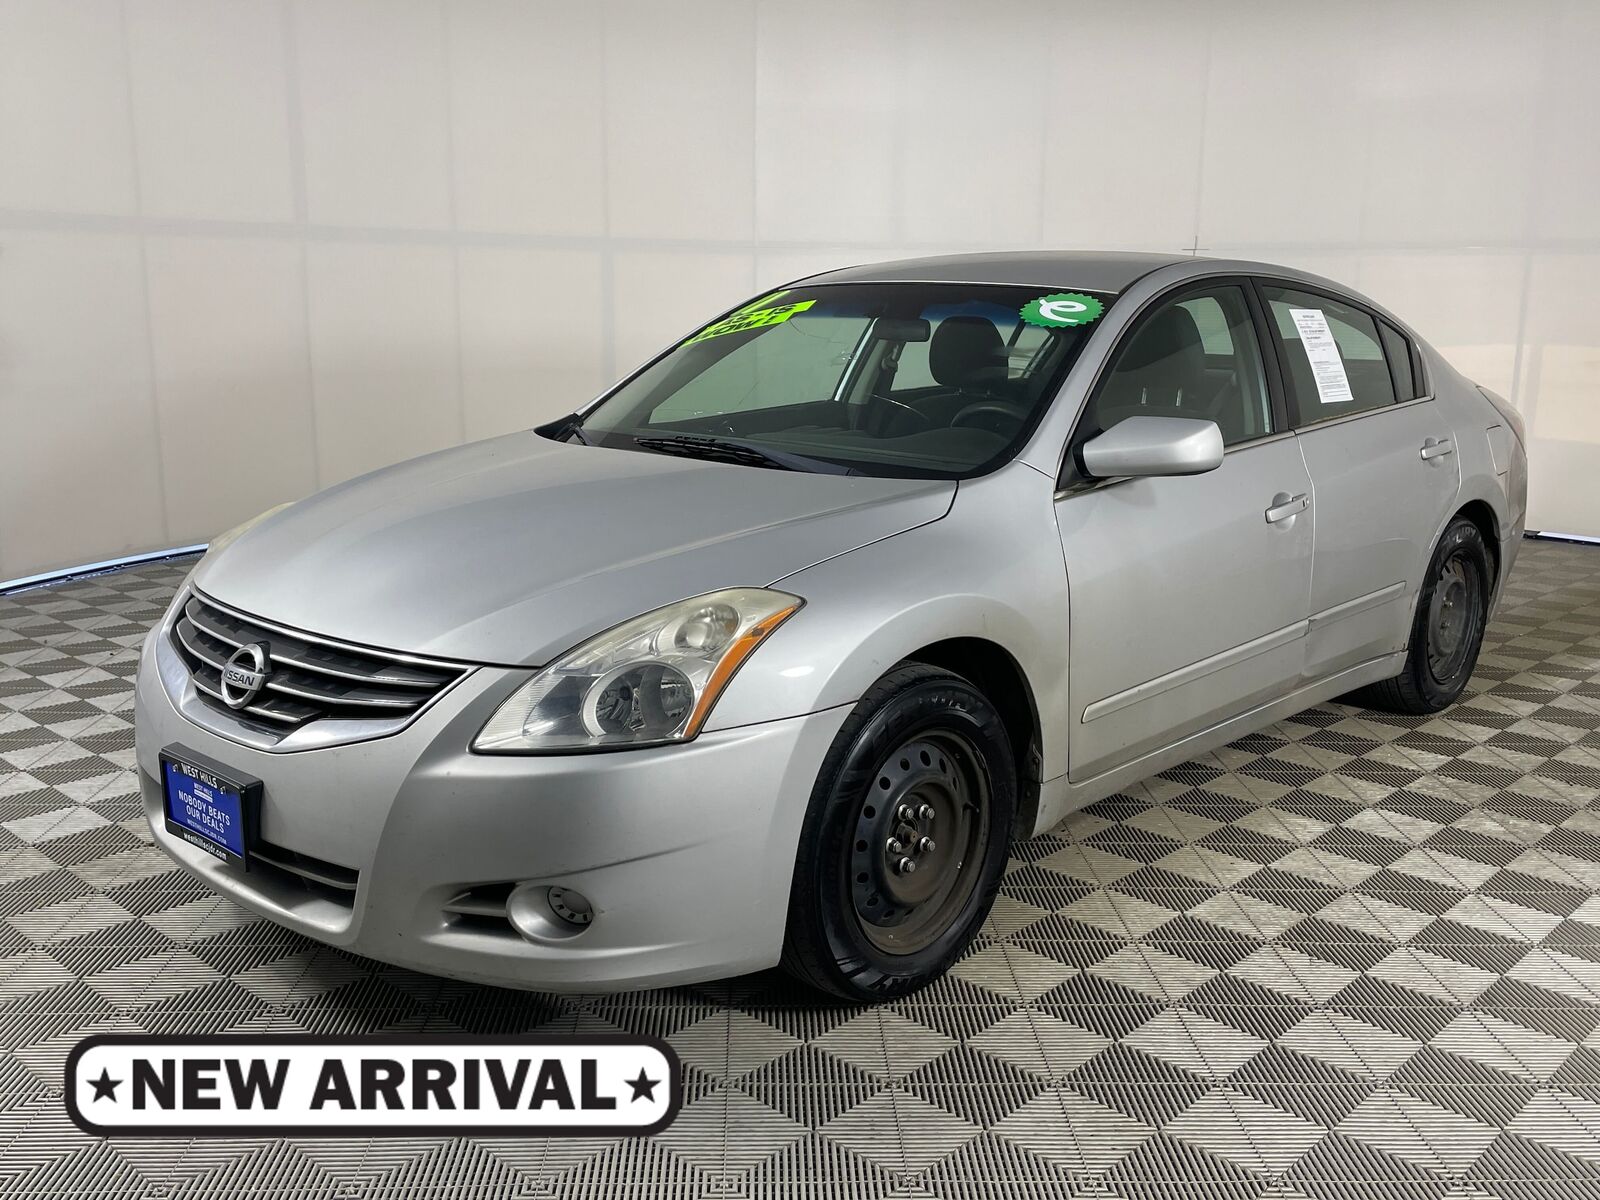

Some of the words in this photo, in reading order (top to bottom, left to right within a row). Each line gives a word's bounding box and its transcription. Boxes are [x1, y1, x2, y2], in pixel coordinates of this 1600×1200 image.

[181, 763, 199, 779] WEST
[200, 771, 218, 789] HILLS
[178, 790, 207, 812] NOBODY
[208, 805, 230, 826] BEATS
[186, 805, 201, 819] OUR
[202, 813, 224, 833] DEALS
